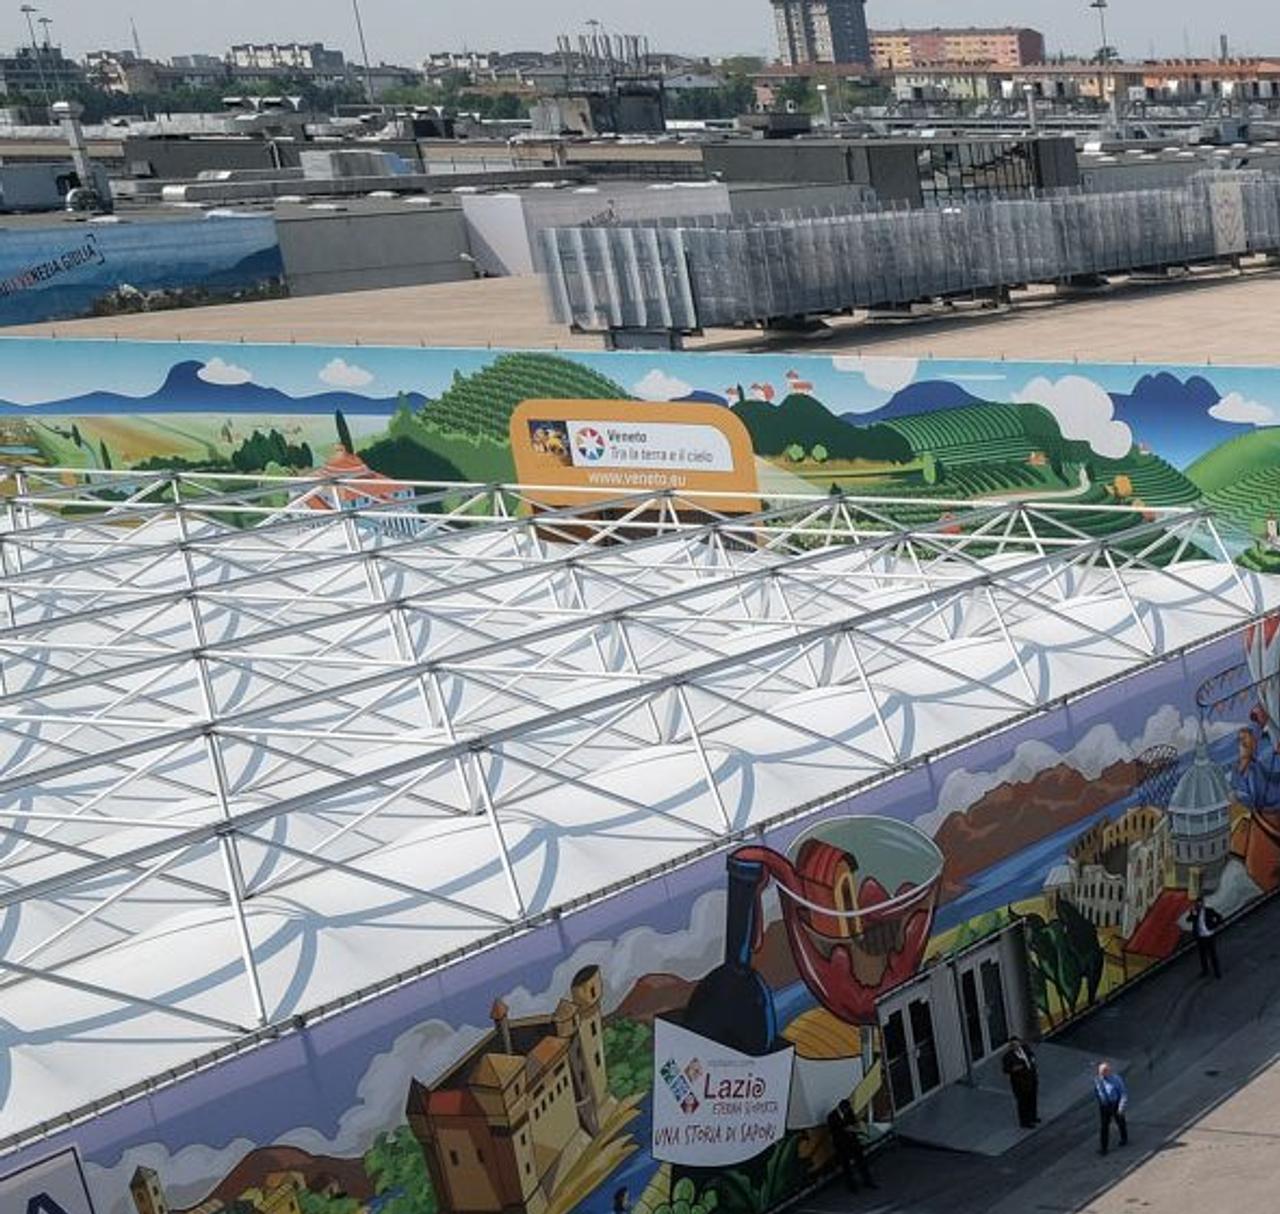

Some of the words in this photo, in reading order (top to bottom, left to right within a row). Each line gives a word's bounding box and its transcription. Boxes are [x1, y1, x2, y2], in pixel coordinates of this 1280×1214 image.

[606, 429, 647, 443] Veneto
[611, 448, 627, 461] Tra
[629, 449, 639, 460] la
[641, 450, 667, 461] terra
[688, 451, 713, 463] cielo
[588, 472, 687, 487] www.veneto.eu
[655, 1126, 680, 1146] UNA
[741, 1121, 777, 1142] SAPORI
